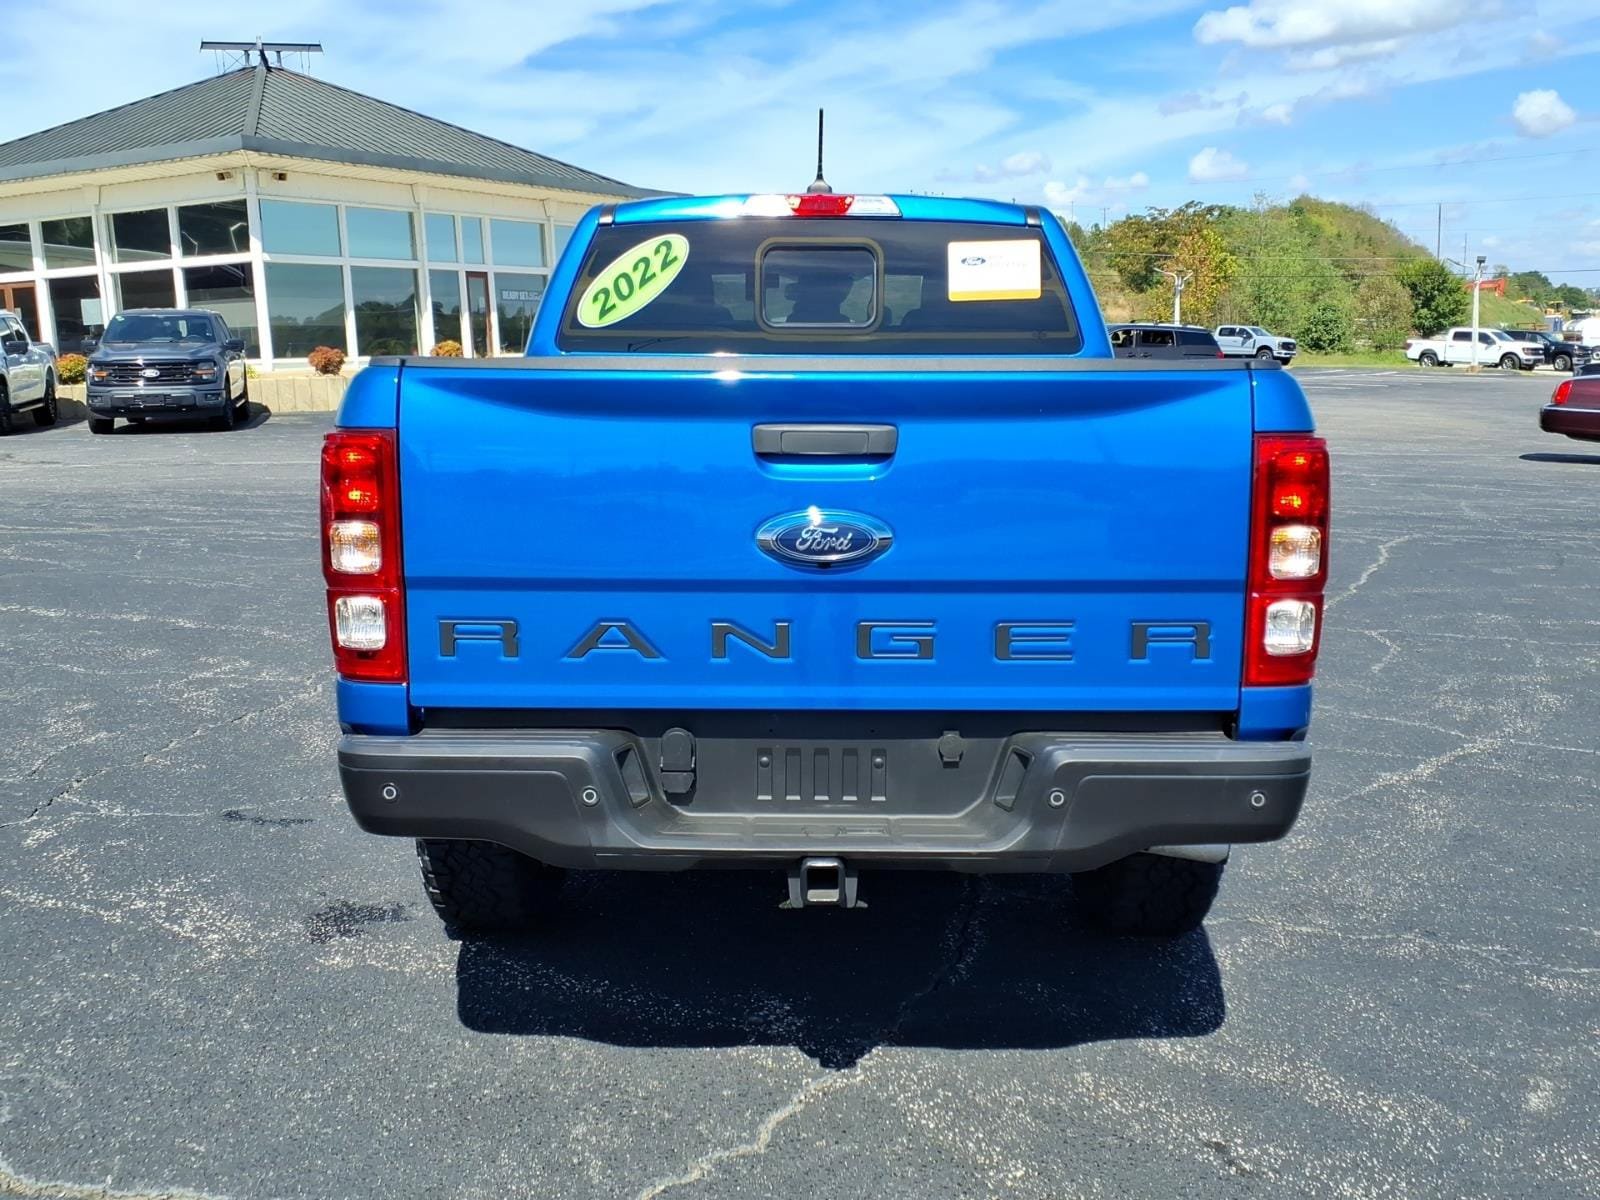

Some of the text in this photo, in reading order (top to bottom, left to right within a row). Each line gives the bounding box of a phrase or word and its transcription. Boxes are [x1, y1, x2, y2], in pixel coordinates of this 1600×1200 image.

[592, 240, 678, 321] 2022
[796, 524, 853, 551] Ford
[438, 618, 1213, 661] RANGER
